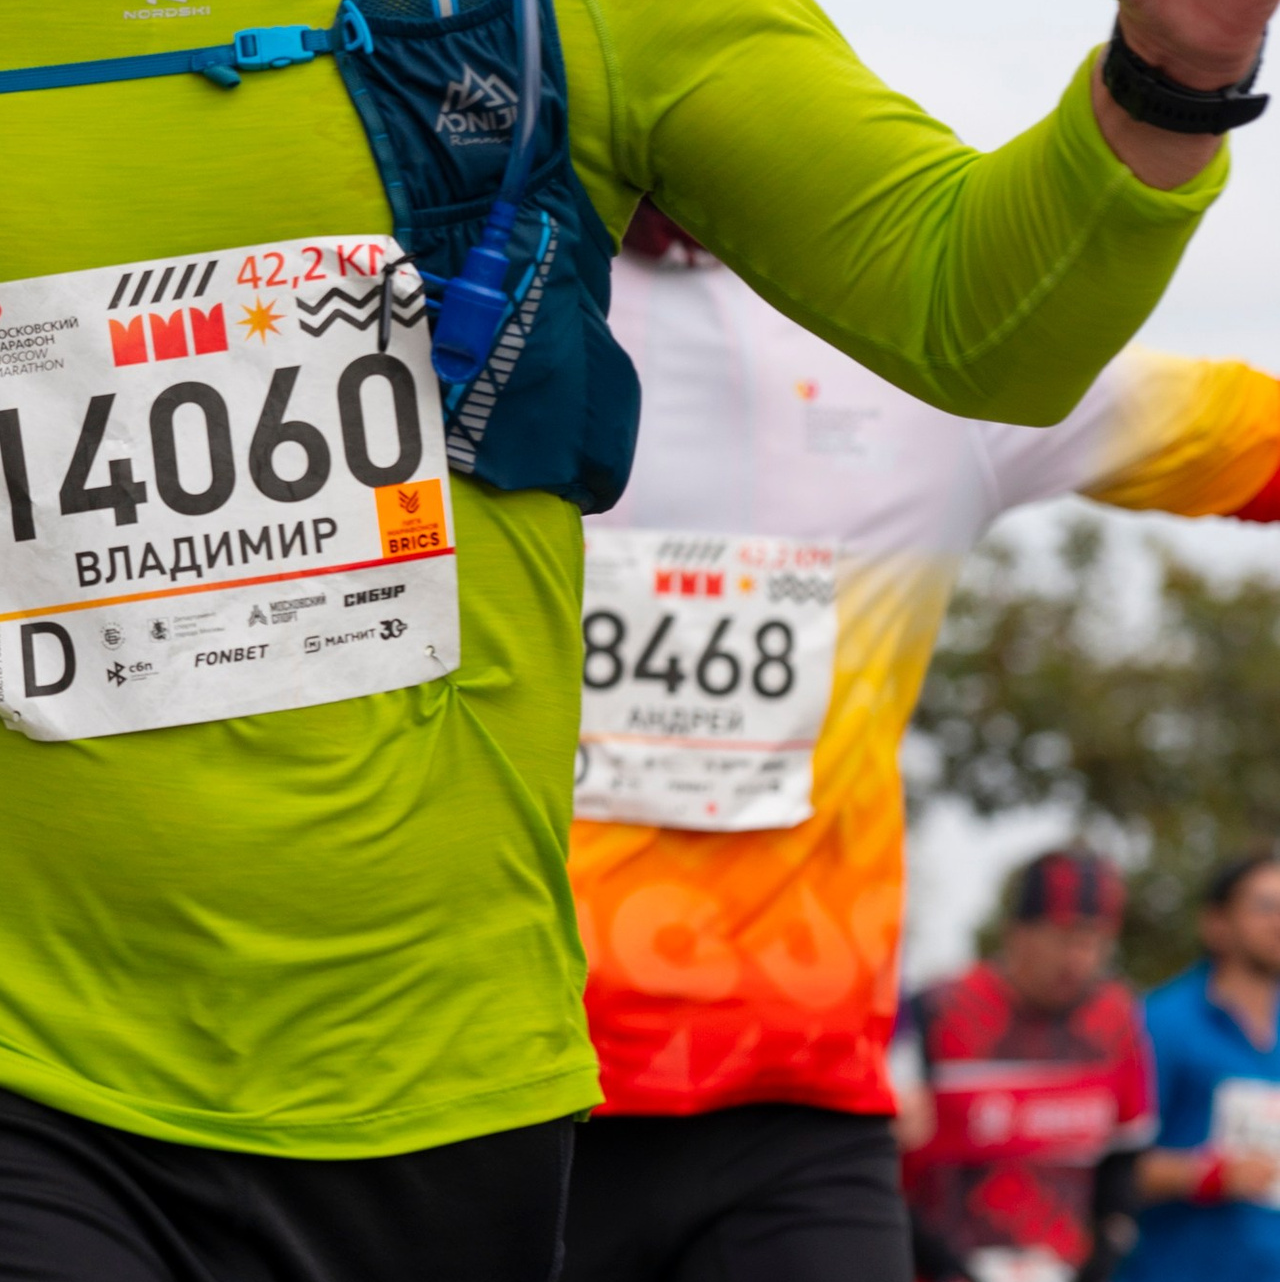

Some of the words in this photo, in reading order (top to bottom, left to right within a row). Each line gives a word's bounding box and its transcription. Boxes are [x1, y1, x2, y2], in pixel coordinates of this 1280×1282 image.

[122, 5, 212, 21] NORDSKI
[236, 246, 327, 290] 42,2
[74, 517, 338, 587] ВЛАДИМИР
[389, 532, 440, 554] BRICS
[344, 584, 406, 608] СИБУР
[325, 628, 377, 648] МАГНИТ
[20, 621, 76, 699] D
[194, 644, 270, 668] FONBET
[583, 610, 795, 698] 8468
